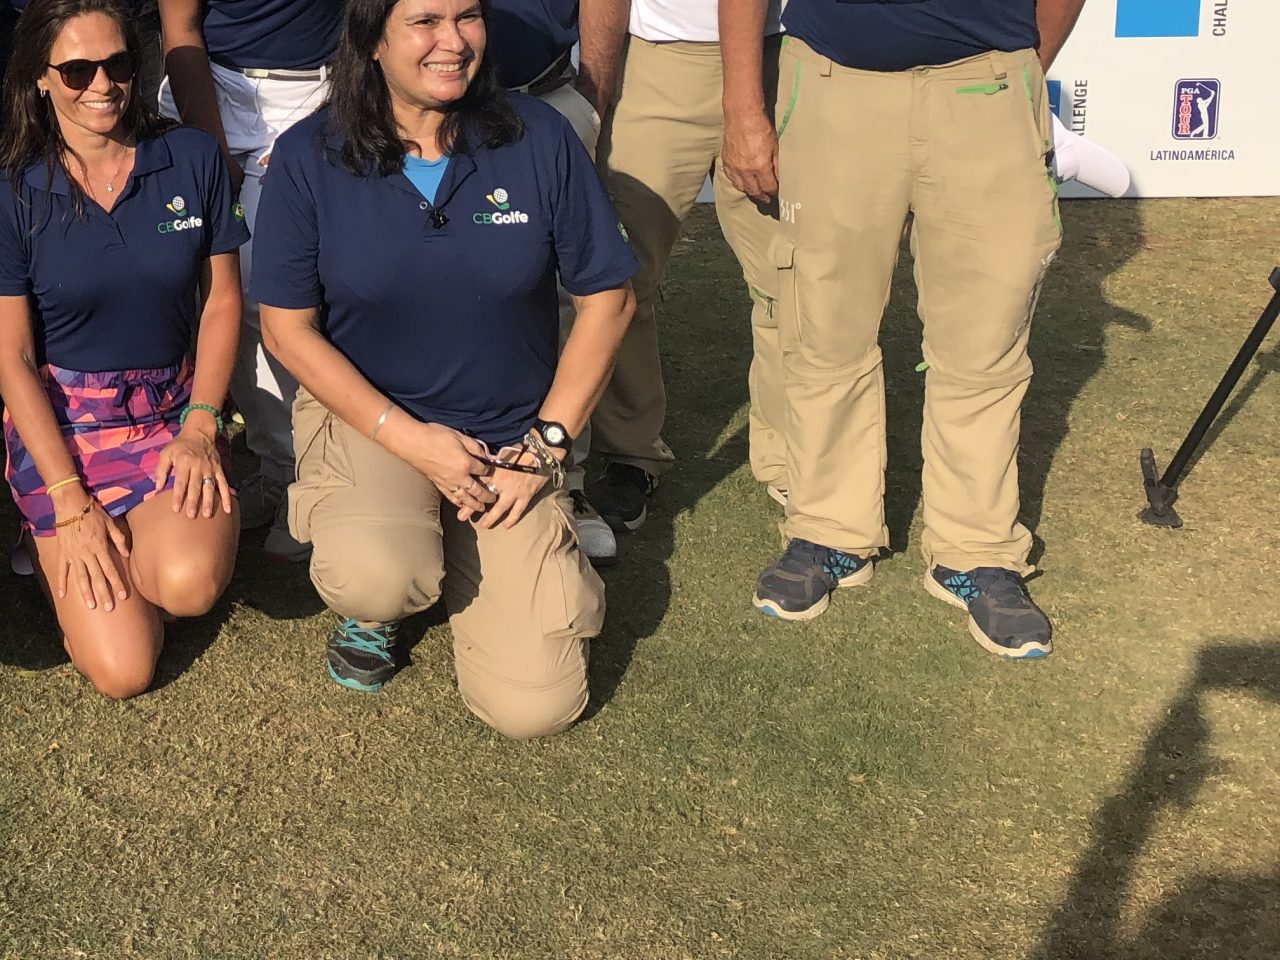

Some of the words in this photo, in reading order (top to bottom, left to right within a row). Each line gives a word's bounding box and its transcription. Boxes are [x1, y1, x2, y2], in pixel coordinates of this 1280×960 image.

[1181, 86, 1200, 94] PGA
[1178, 95, 1193, 135] TOUR
[1151, 148, 1234, 160] LATINOAMÉRICA
[472, 211, 528, 224] CBGolfe
[157, 215, 203, 234] CBGolfe
